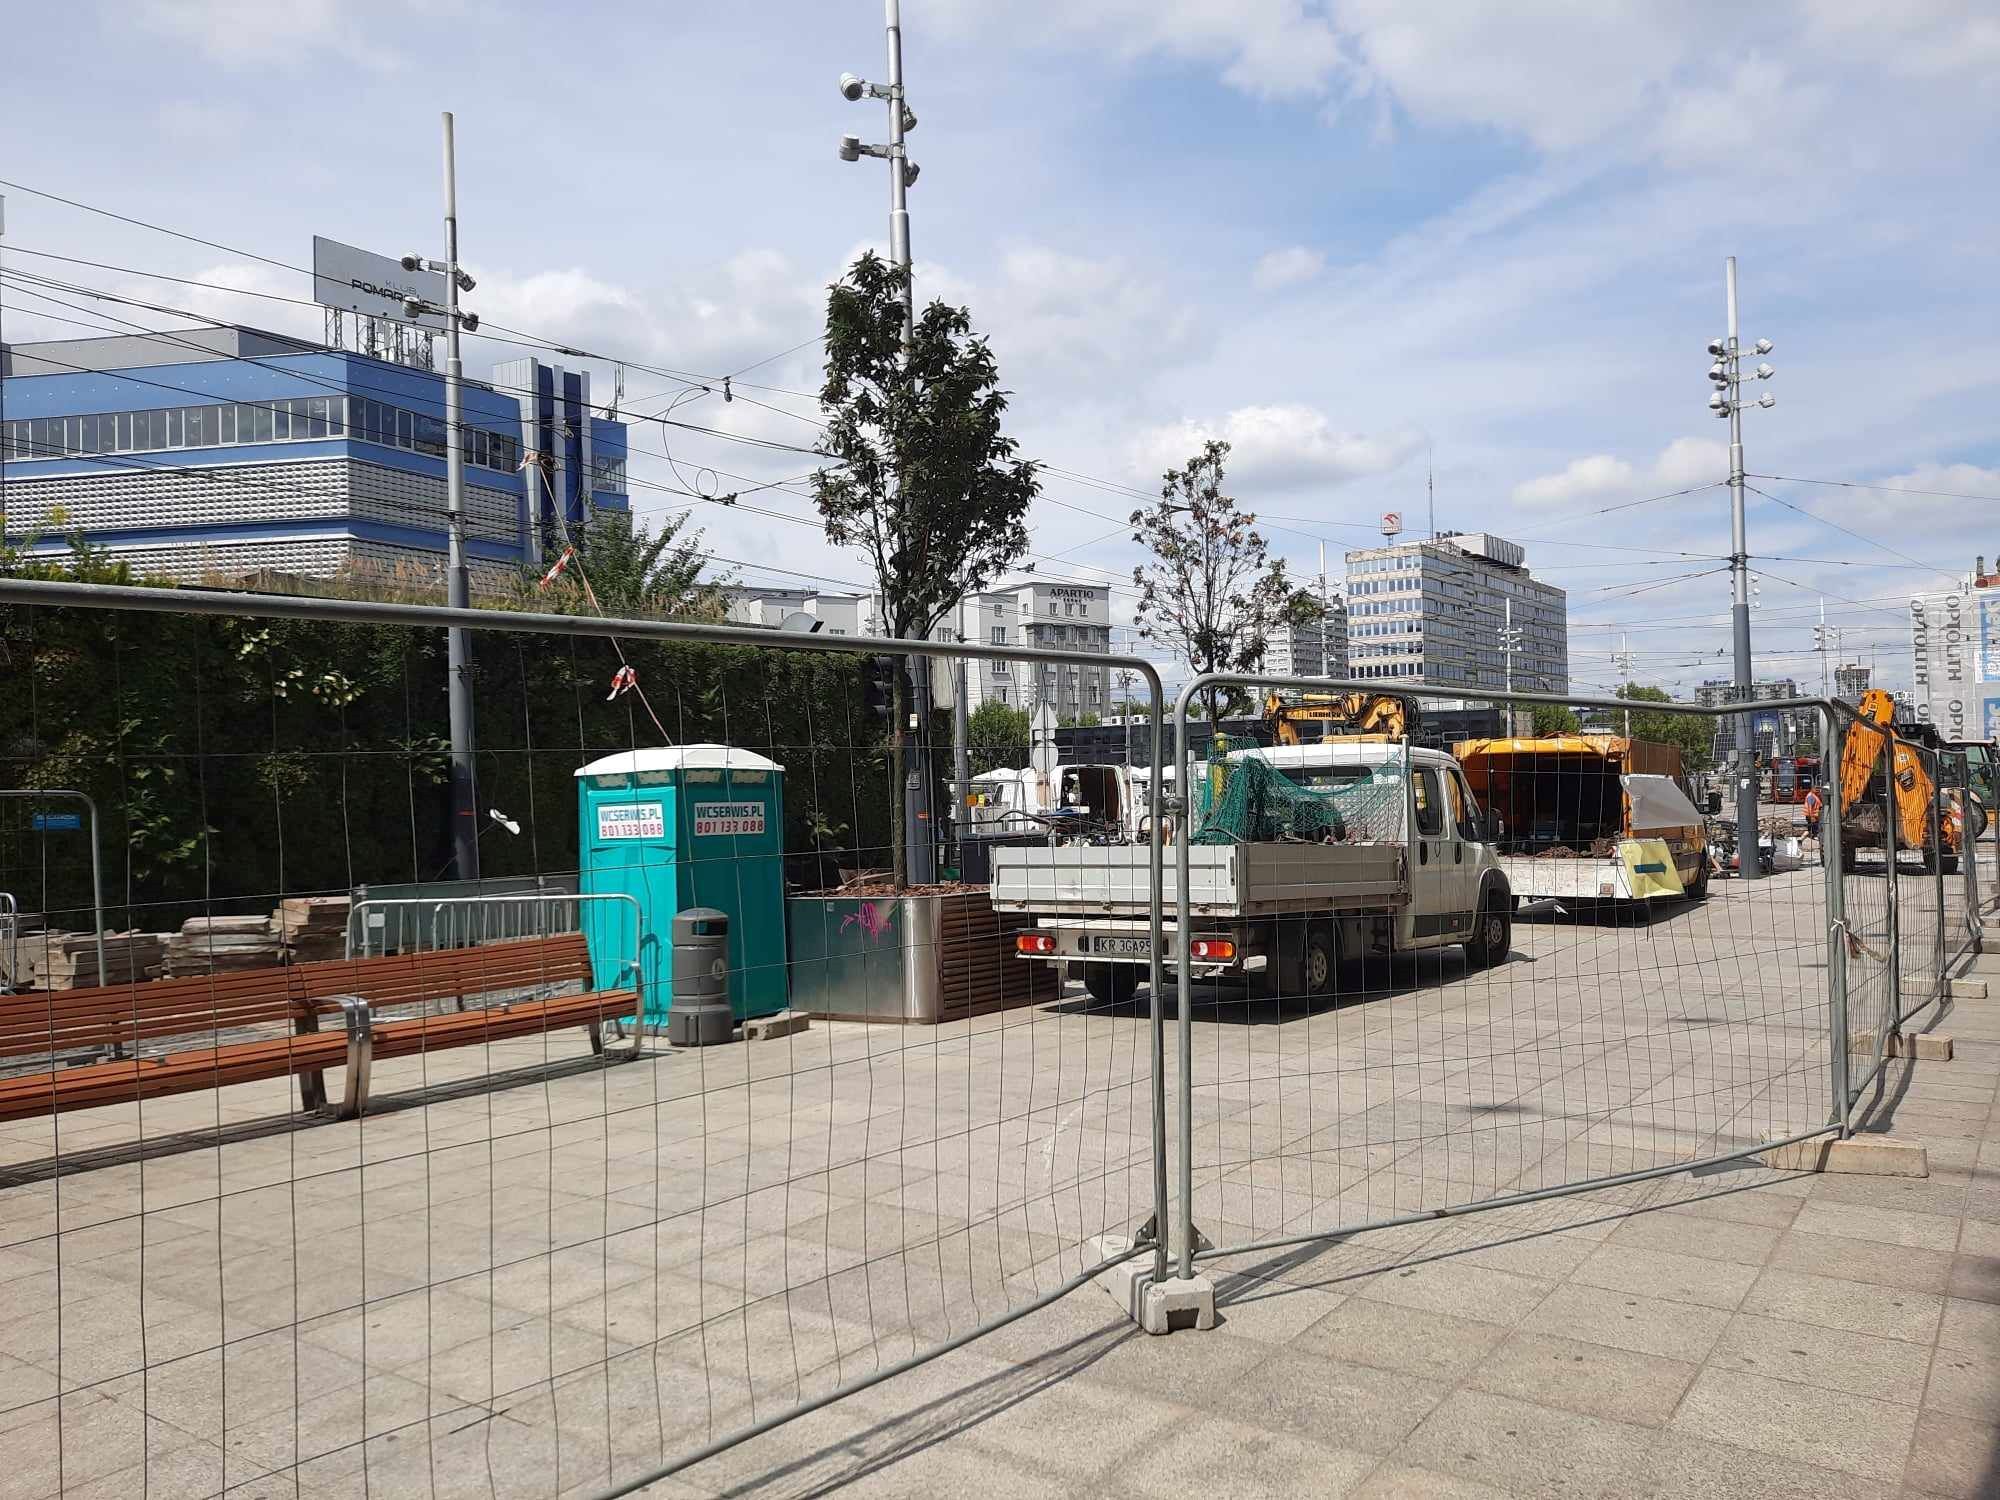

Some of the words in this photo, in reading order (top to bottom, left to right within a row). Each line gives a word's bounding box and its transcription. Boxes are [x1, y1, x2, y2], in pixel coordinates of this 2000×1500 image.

[385, 279, 417, 295] KLUB
[1050, 588, 1094, 599] APARTIO
[1911, 600, 1928, 685] OPTOLITH
[1946, 595, 1962, 681] OPTOLITH
[600, 808, 662, 822] WCSERWIS.PL
[696, 806, 763, 818] WCSERWIS.PL
[601, 825, 619, 837] 801
[621, 824, 640, 836] 133
[642, 823, 662, 835] 088
[696, 822, 716, 834] 801
[721, 821, 738, 833] 133
[742, 820, 764, 832] 088
[1100, 939, 1116, 951] KR
